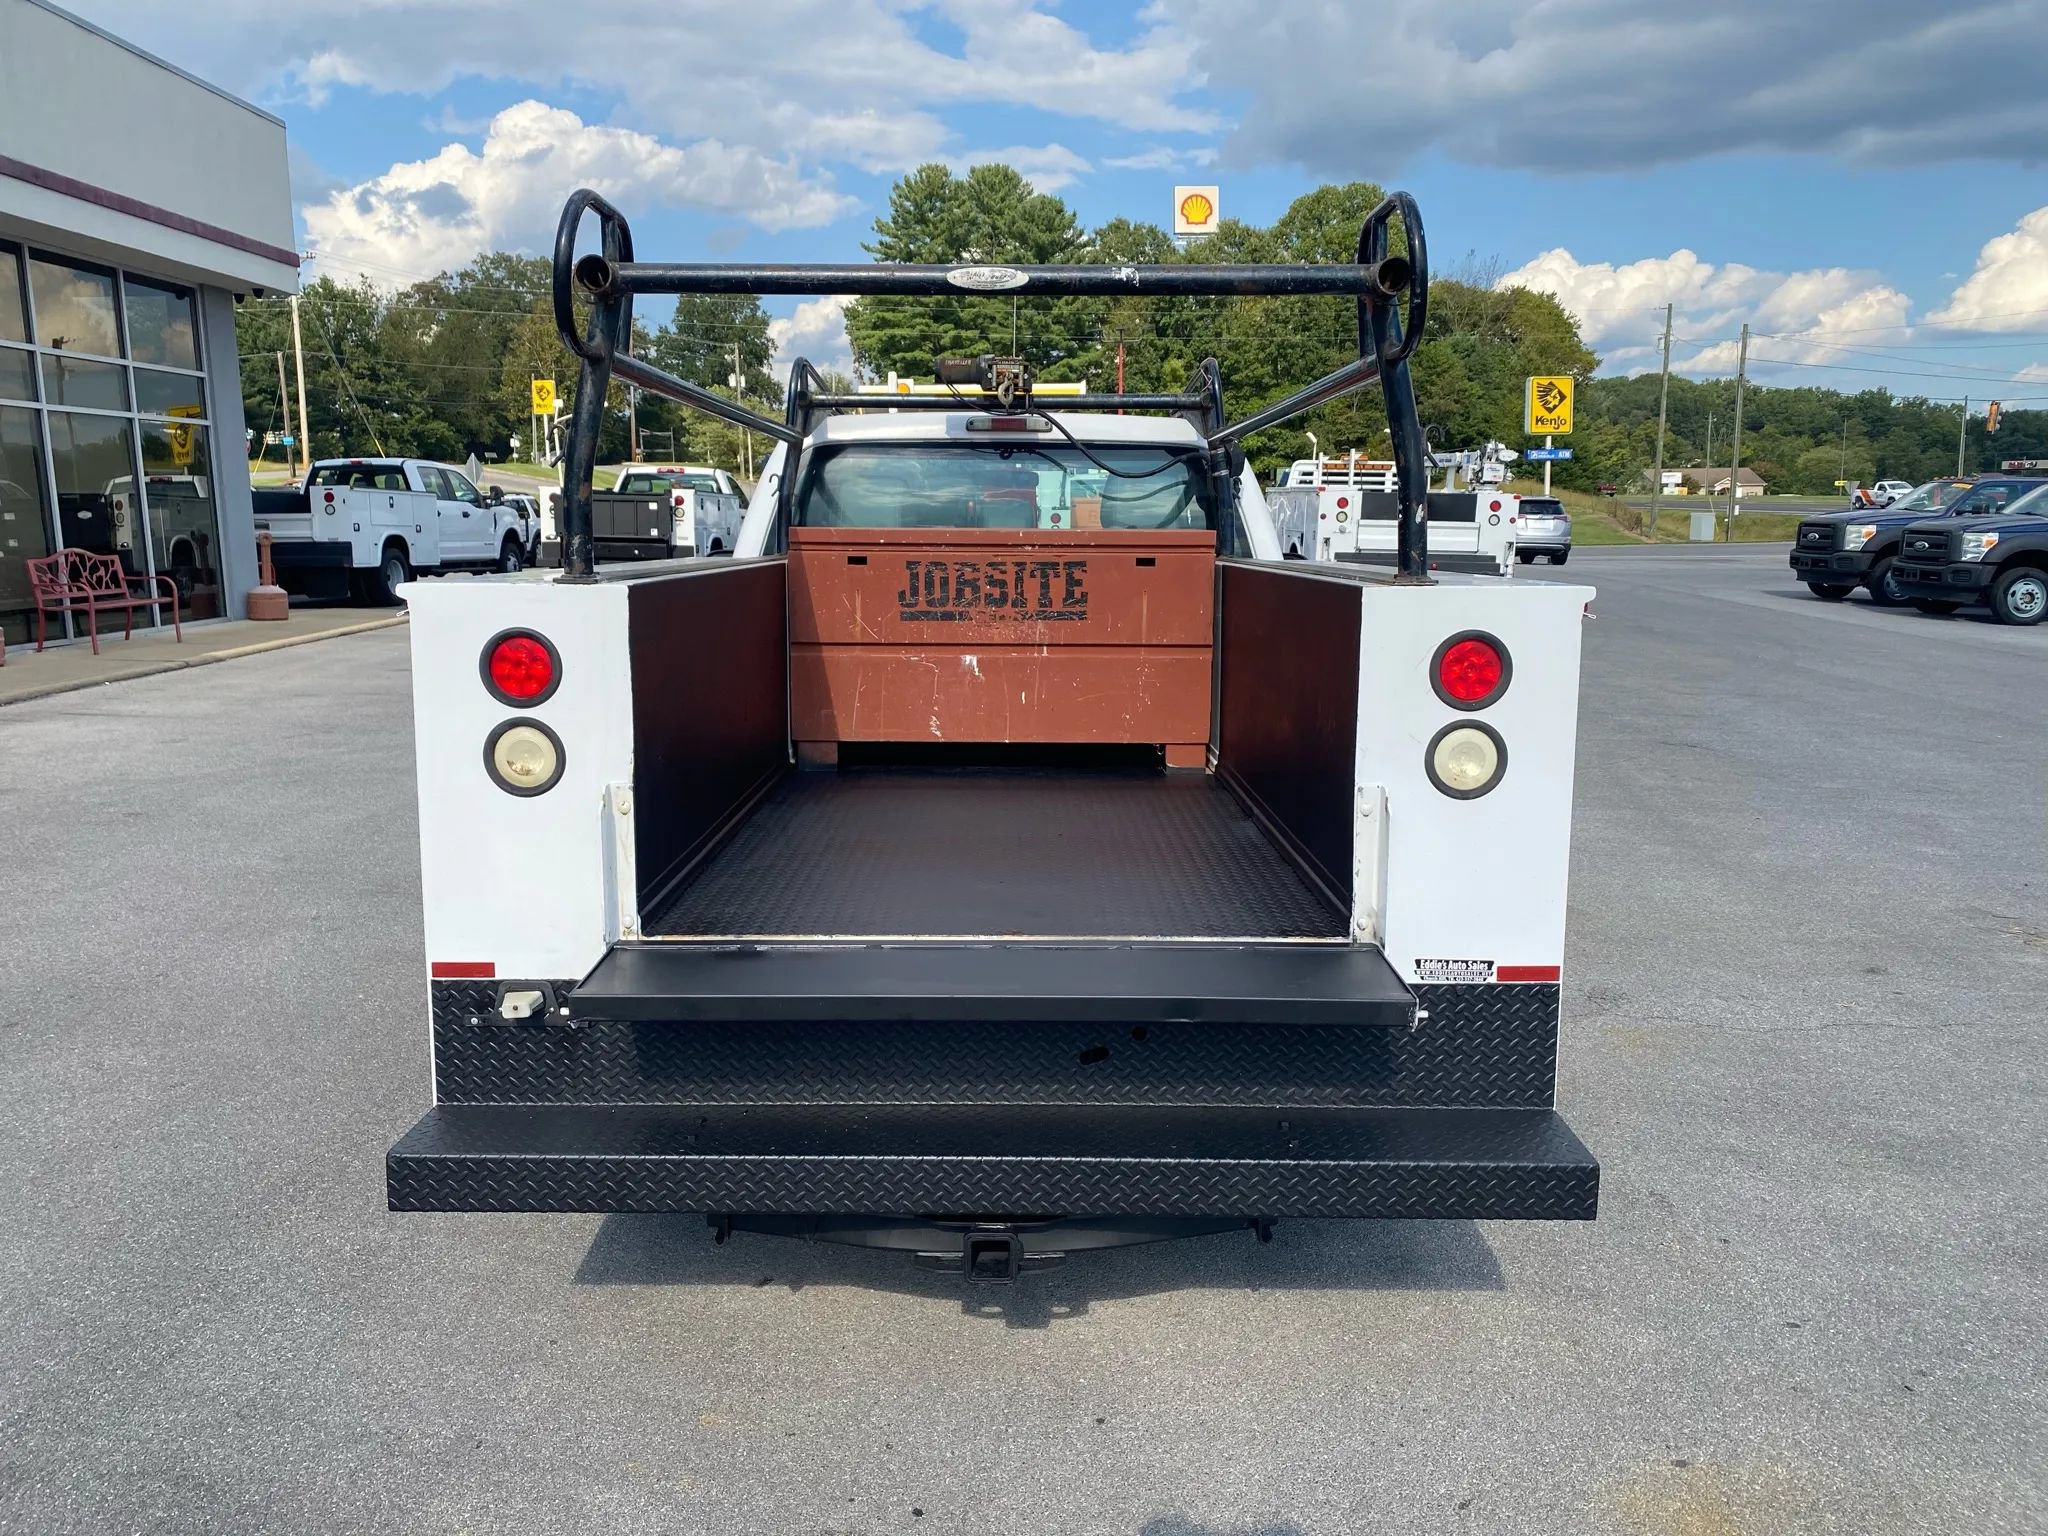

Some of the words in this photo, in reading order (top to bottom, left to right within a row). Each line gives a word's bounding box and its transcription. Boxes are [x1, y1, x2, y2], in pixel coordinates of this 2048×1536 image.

[1535, 415, 1567, 430] Kenjo
[898, 560, 1089, 609] JOBSITE
[1420, 959, 1447, 969] Eddie's
[1448, 960, 1466, 970] Auto
[1467, 960, 1489, 970] Sales
